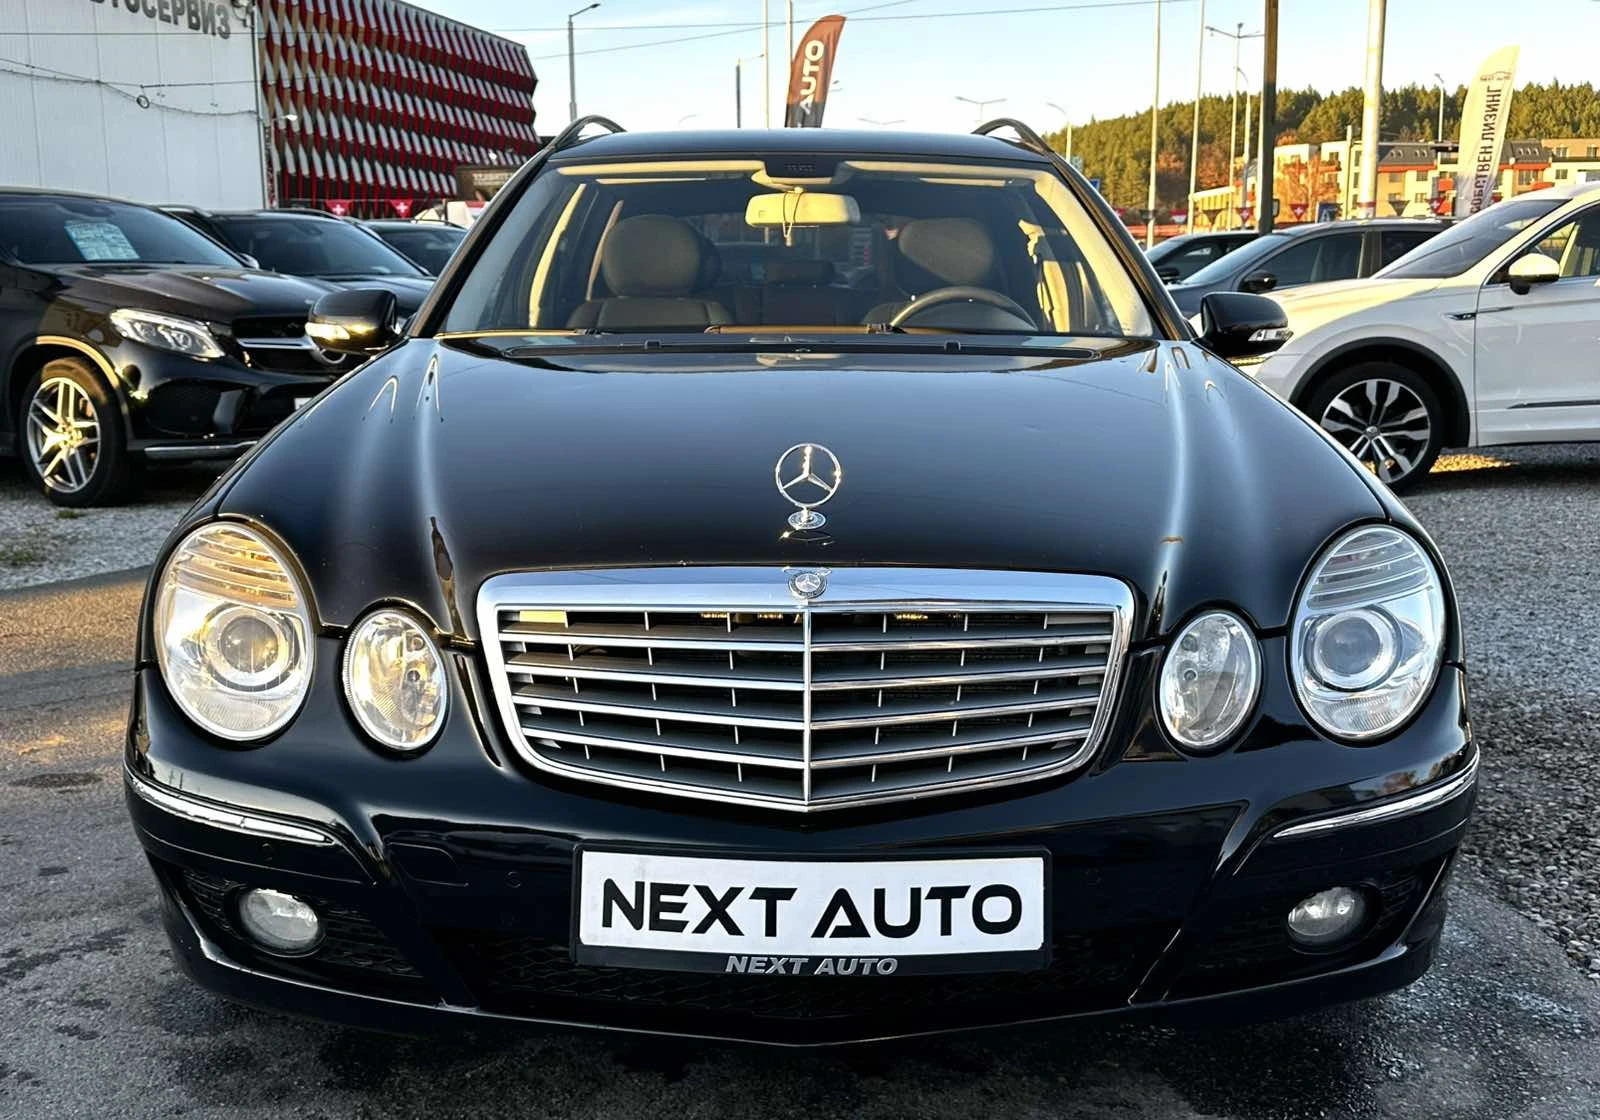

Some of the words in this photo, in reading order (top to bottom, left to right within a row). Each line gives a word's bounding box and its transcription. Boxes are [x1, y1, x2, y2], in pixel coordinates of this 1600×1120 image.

[90, 0, 231, 39] СЕРВИЗ
[800, 39, 825, 115] AUTO
[1481, 86, 1502, 141] ЛИЗИНГ
[601, 878, 798, 938] NEXT
[810, 884, 1023, 939] AUTO
[725, 955, 808, 975] NEXT
[813, 957, 899, 976] AUTO
